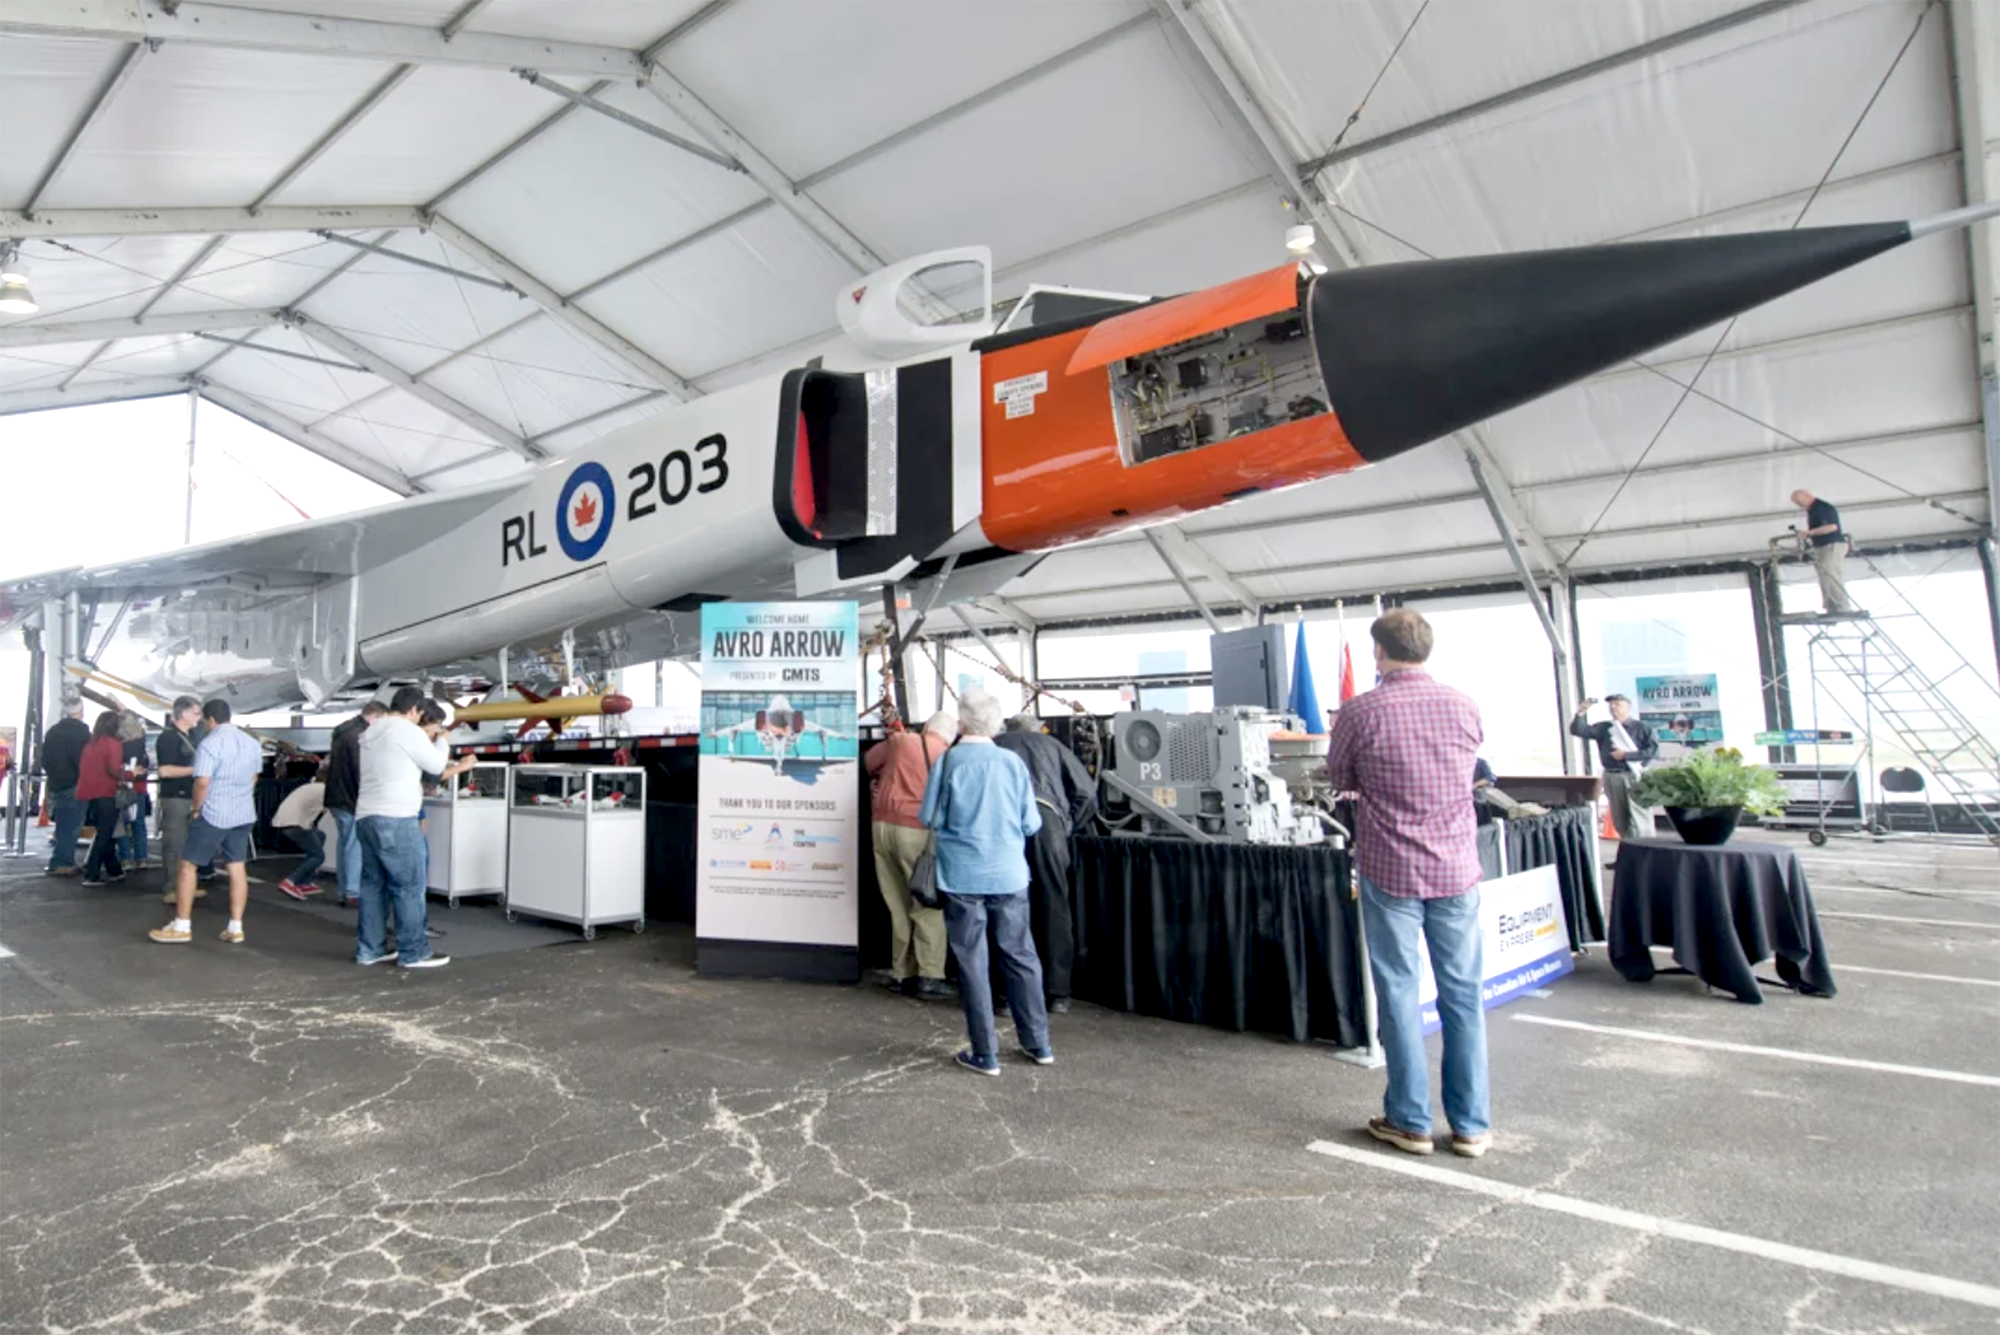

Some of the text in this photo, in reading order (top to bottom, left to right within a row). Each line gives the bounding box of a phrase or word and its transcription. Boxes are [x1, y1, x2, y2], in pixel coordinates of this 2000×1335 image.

[627, 432, 729, 522] 203
[502, 510, 547, 567] RL
[746, 613, 810, 625] WELCOME HOME
[713, 629, 844, 658] AVRO ARROW
[730, 671, 765, 681] PRESENTED
[781, 667, 820, 682] CMTS
[1642, 684, 1713, 700] AVRO ARROW
[1140, 762, 1162, 781] P3
[719, 798, 837, 812] THANK YOU TO OUR SPONSORS
[712, 827, 742, 841] sme
